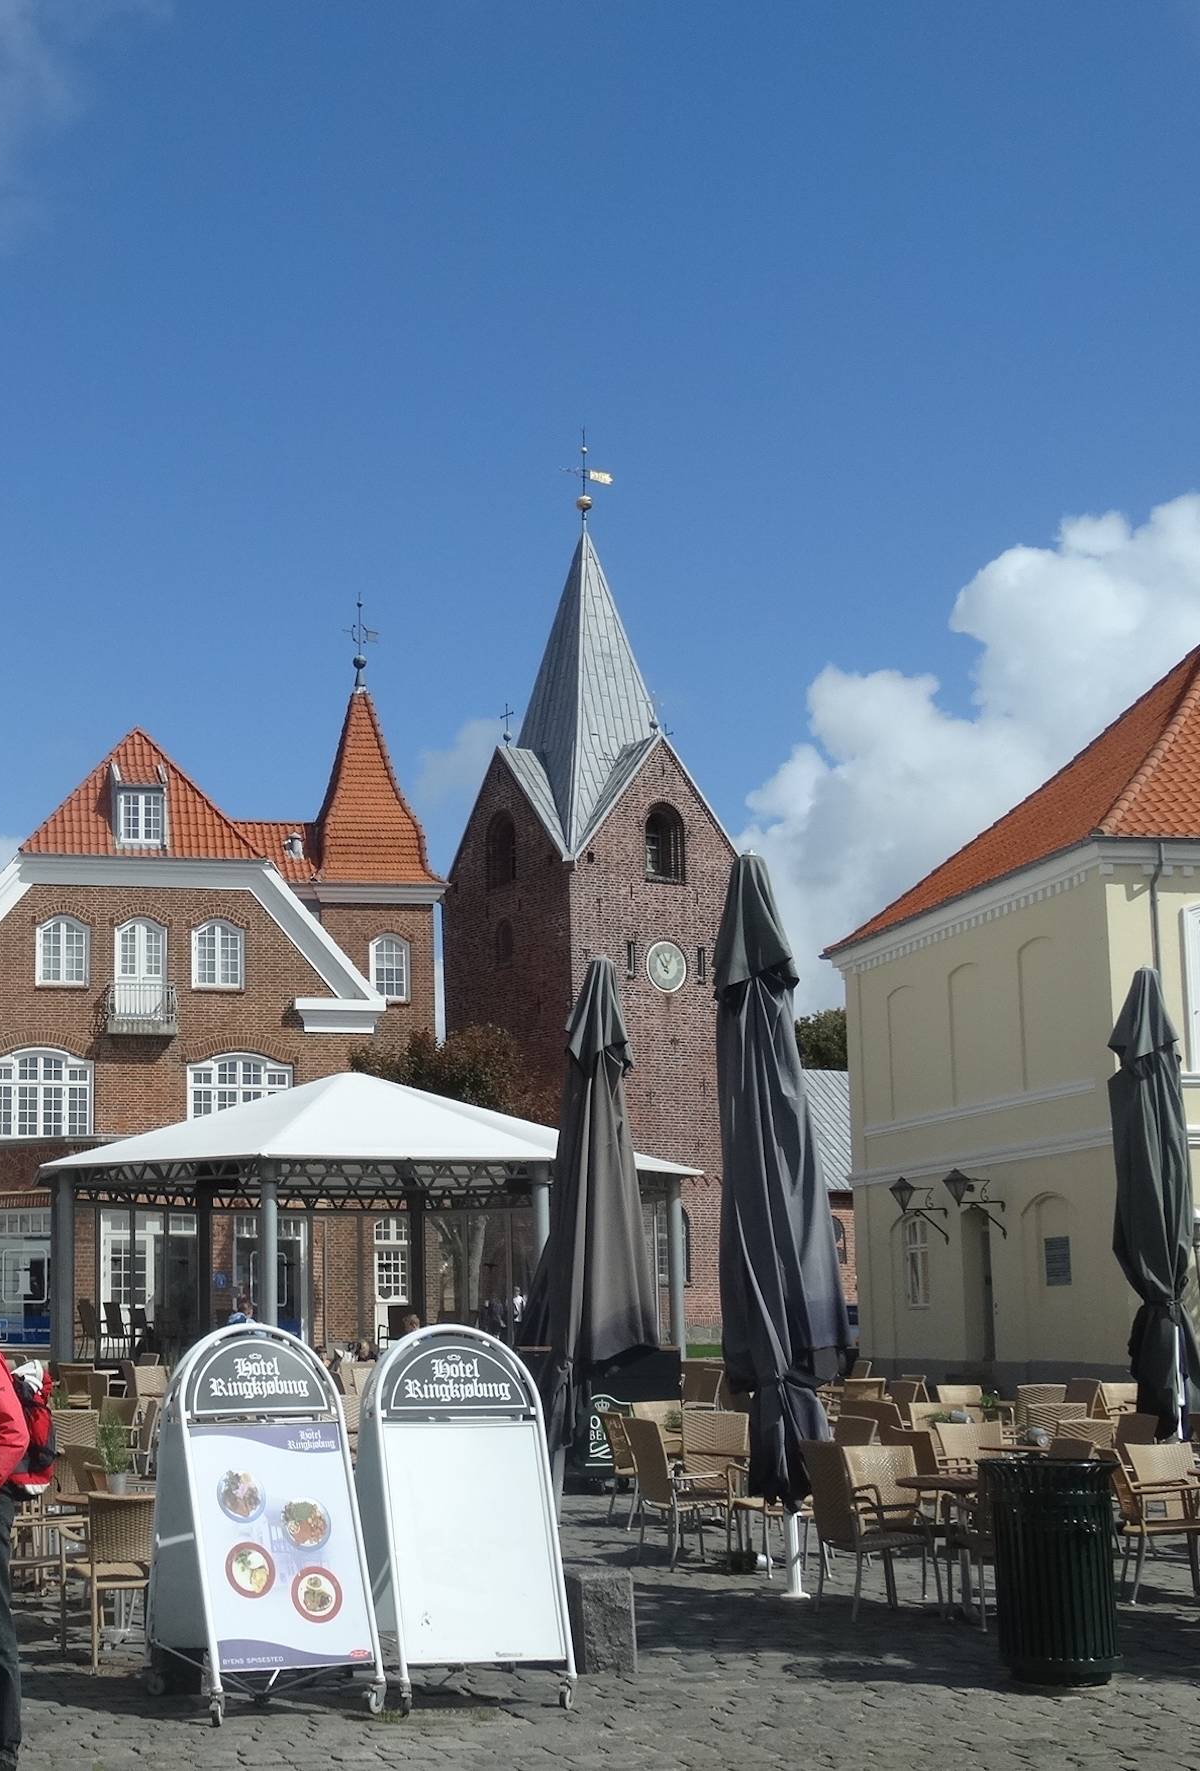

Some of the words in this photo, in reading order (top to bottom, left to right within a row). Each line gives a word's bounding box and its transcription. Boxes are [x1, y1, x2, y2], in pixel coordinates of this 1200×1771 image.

[233, 1357, 281, 1380] Hotel
[430, 1358, 481, 1381] Hotel
[208, 1376, 310, 1399] Ringkjøbing
[404, 1378, 512, 1402] Ringkjøbing
[298, 1429, 322, 1441] Hotel
[222, 1657, 244, 1665] BYENS
[246, 1655, 284, 1664] SPISESTED
